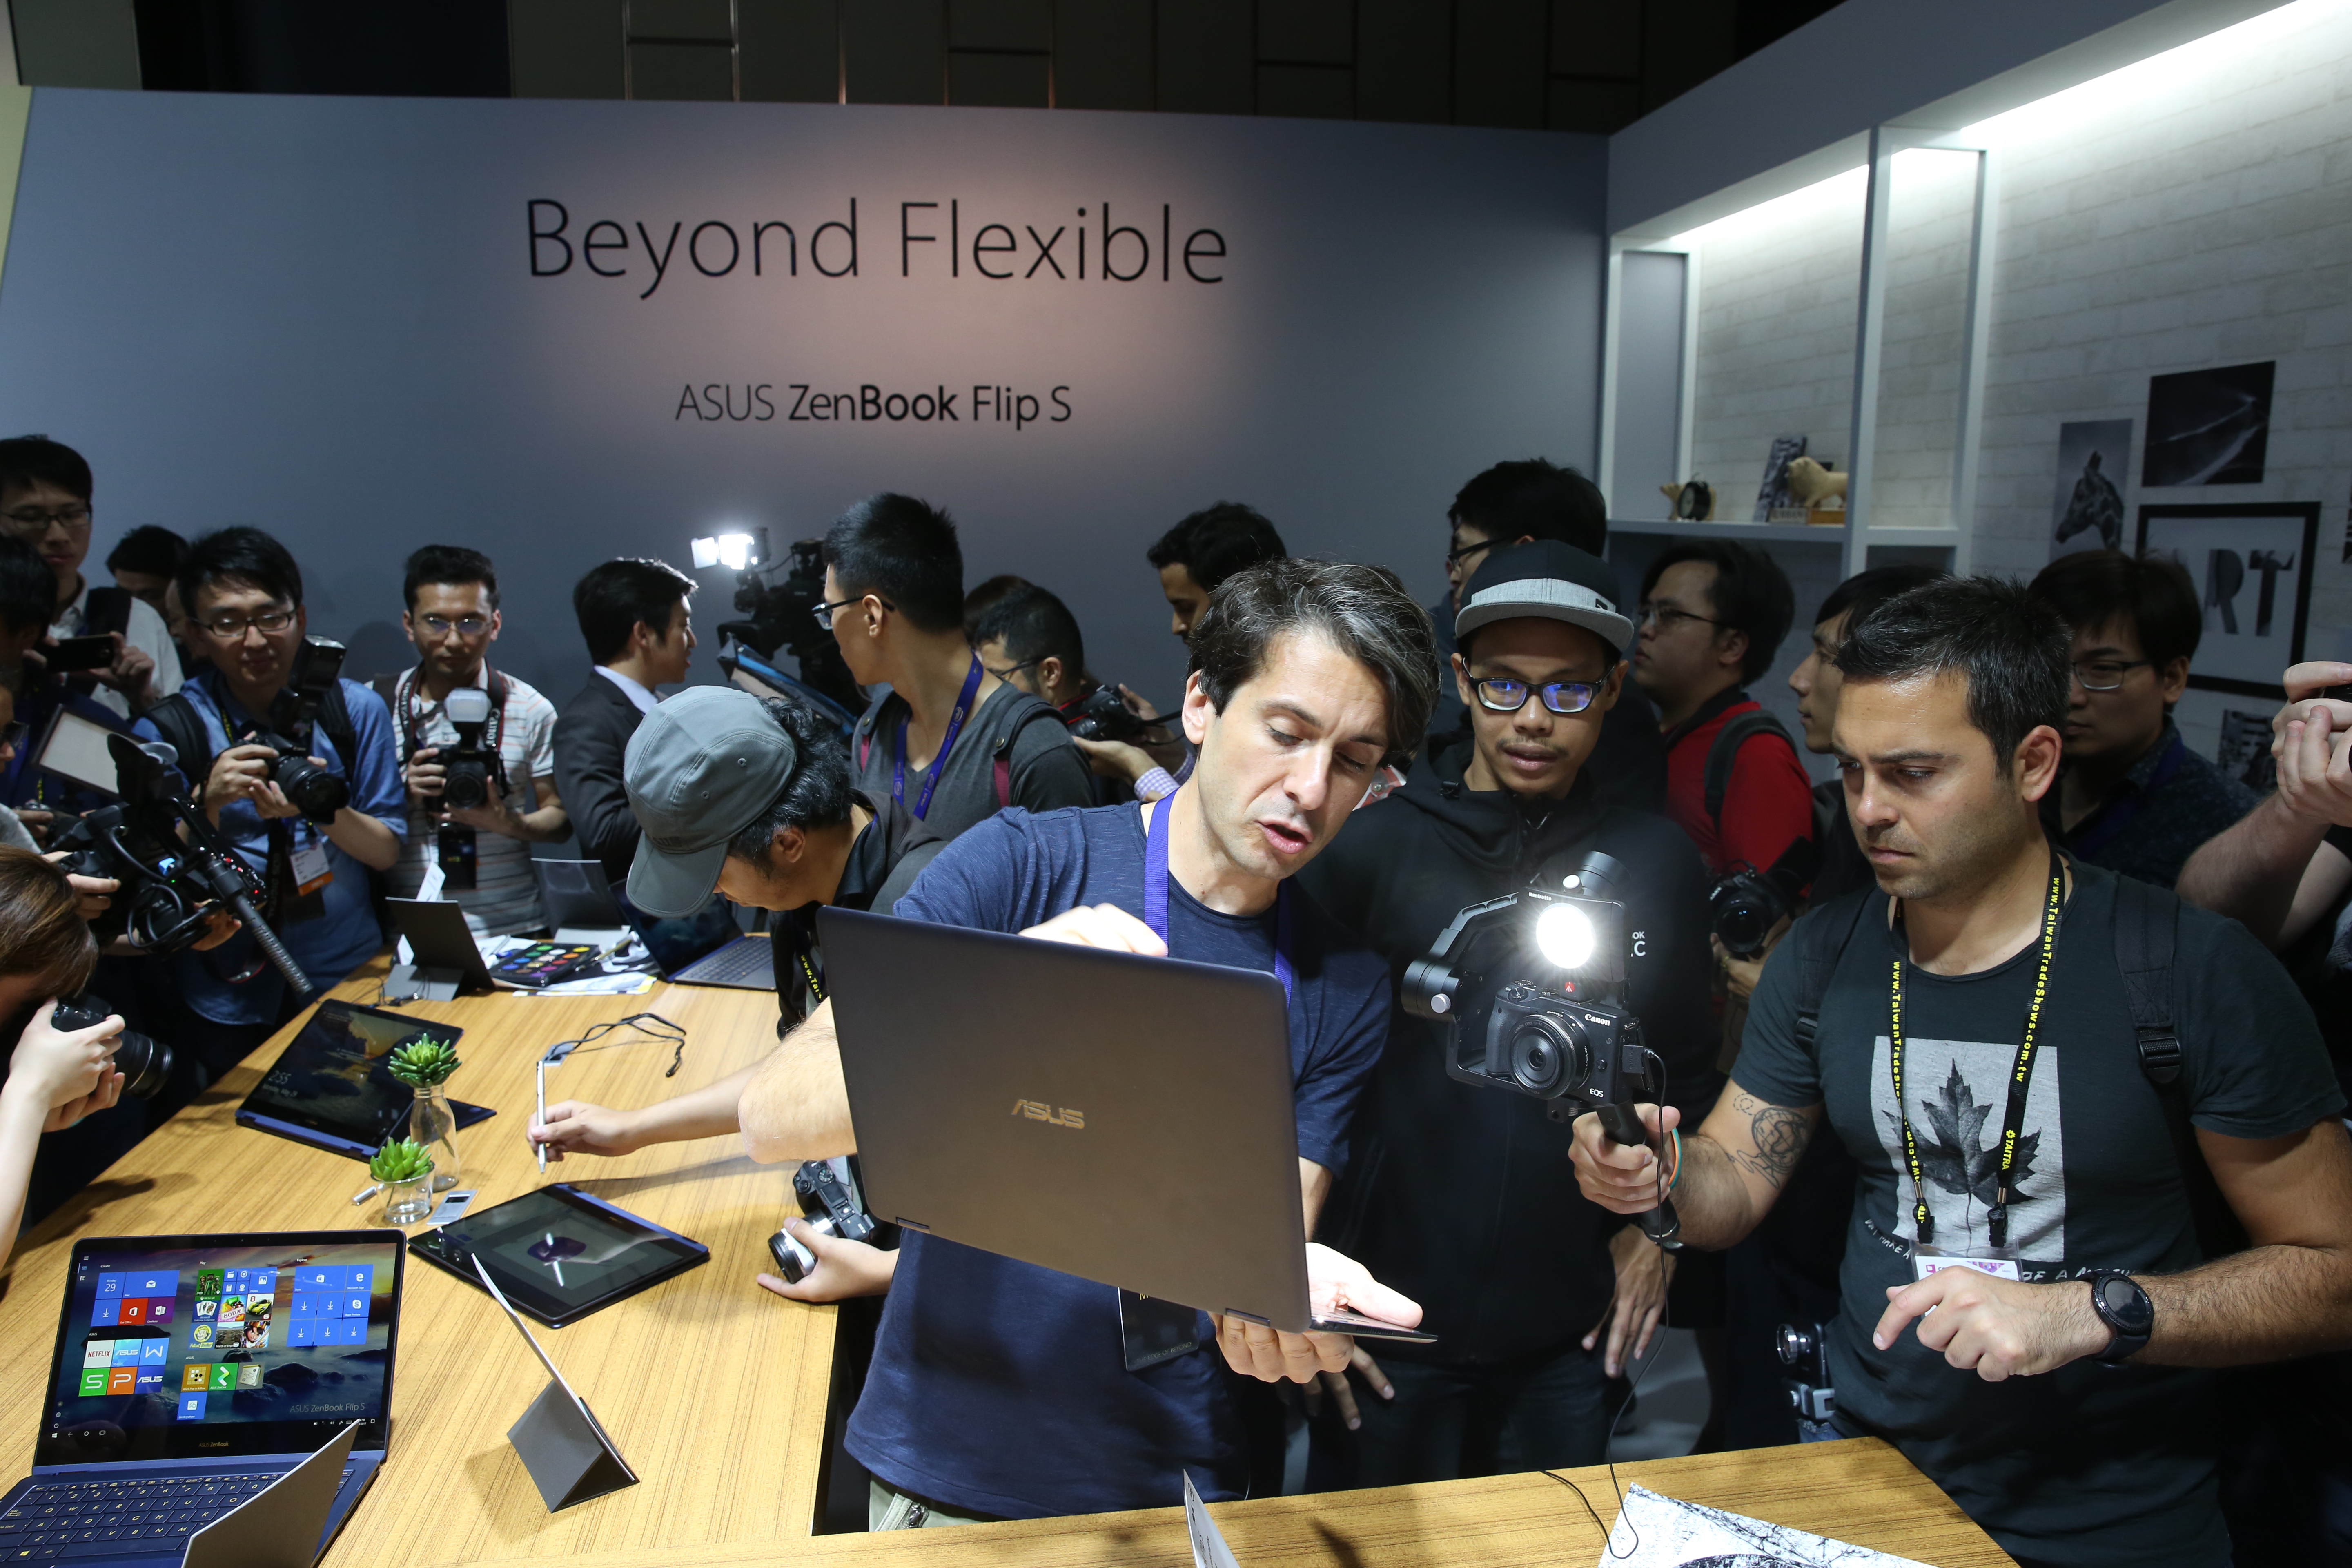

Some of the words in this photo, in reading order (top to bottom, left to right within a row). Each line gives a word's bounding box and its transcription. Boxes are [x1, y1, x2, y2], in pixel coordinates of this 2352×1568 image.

[527, 198, 859, 300] Beyond
[901, 198, 1227, 285] Flexible
[675, 384, 775, 422] ASUS
[788, 384, 959, 422] ZenBook
[973, 384, 1040, 431] Flip
[1049, 385, 1072, 423] S
[1529, 892, 1552, 901] Manfrotto
[2016, 877, 2059, 1082] www.TaiwanTradeShows.com.tw
[1585, 1014, 1610, 1026] Canon
[1514, 1024, 1524, 1033] CANON
[1590, 1088, 1604, 1098] EOS
[1011, 1099, 1085, 1129] ASUS
[2002, 1139, 2014, 1171] TAITRA
[105, 1283, 116, 1292] 29
[223, 1309, 241, 1319] SODA
[145, 1346, 163, 1358] W
[1170, 1342, 1192, 1353] BEYOND
[85, 1374, 104, 1389] S
[113, 1374, 132, 1388] P
[311, 1404, 344, 1412] ZenBook
[345, 1403, 359, 1412] Flip
